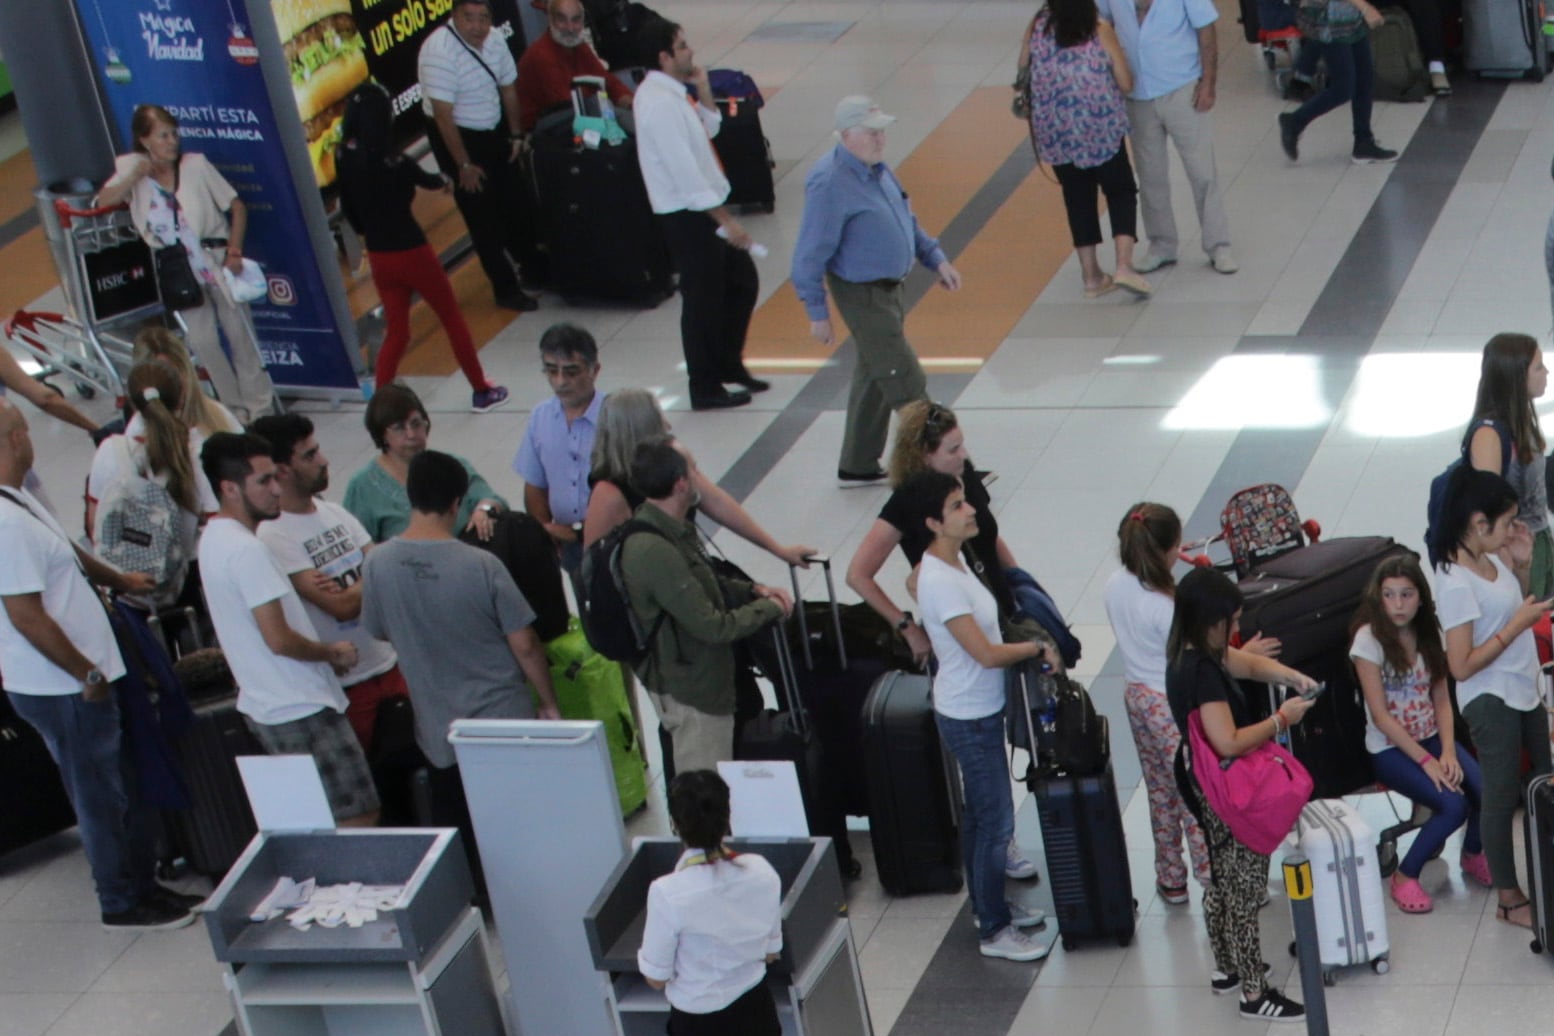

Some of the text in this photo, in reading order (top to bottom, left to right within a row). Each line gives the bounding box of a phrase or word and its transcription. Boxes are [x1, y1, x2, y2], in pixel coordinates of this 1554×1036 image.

[370, 21, 394, 56] un
[392, 0, 426, 42] solo
[142, 31, 204, 61] Navidad
[218, 108, 259, 124] ESTA
[218, 126, 264, 141] MÁGICA
